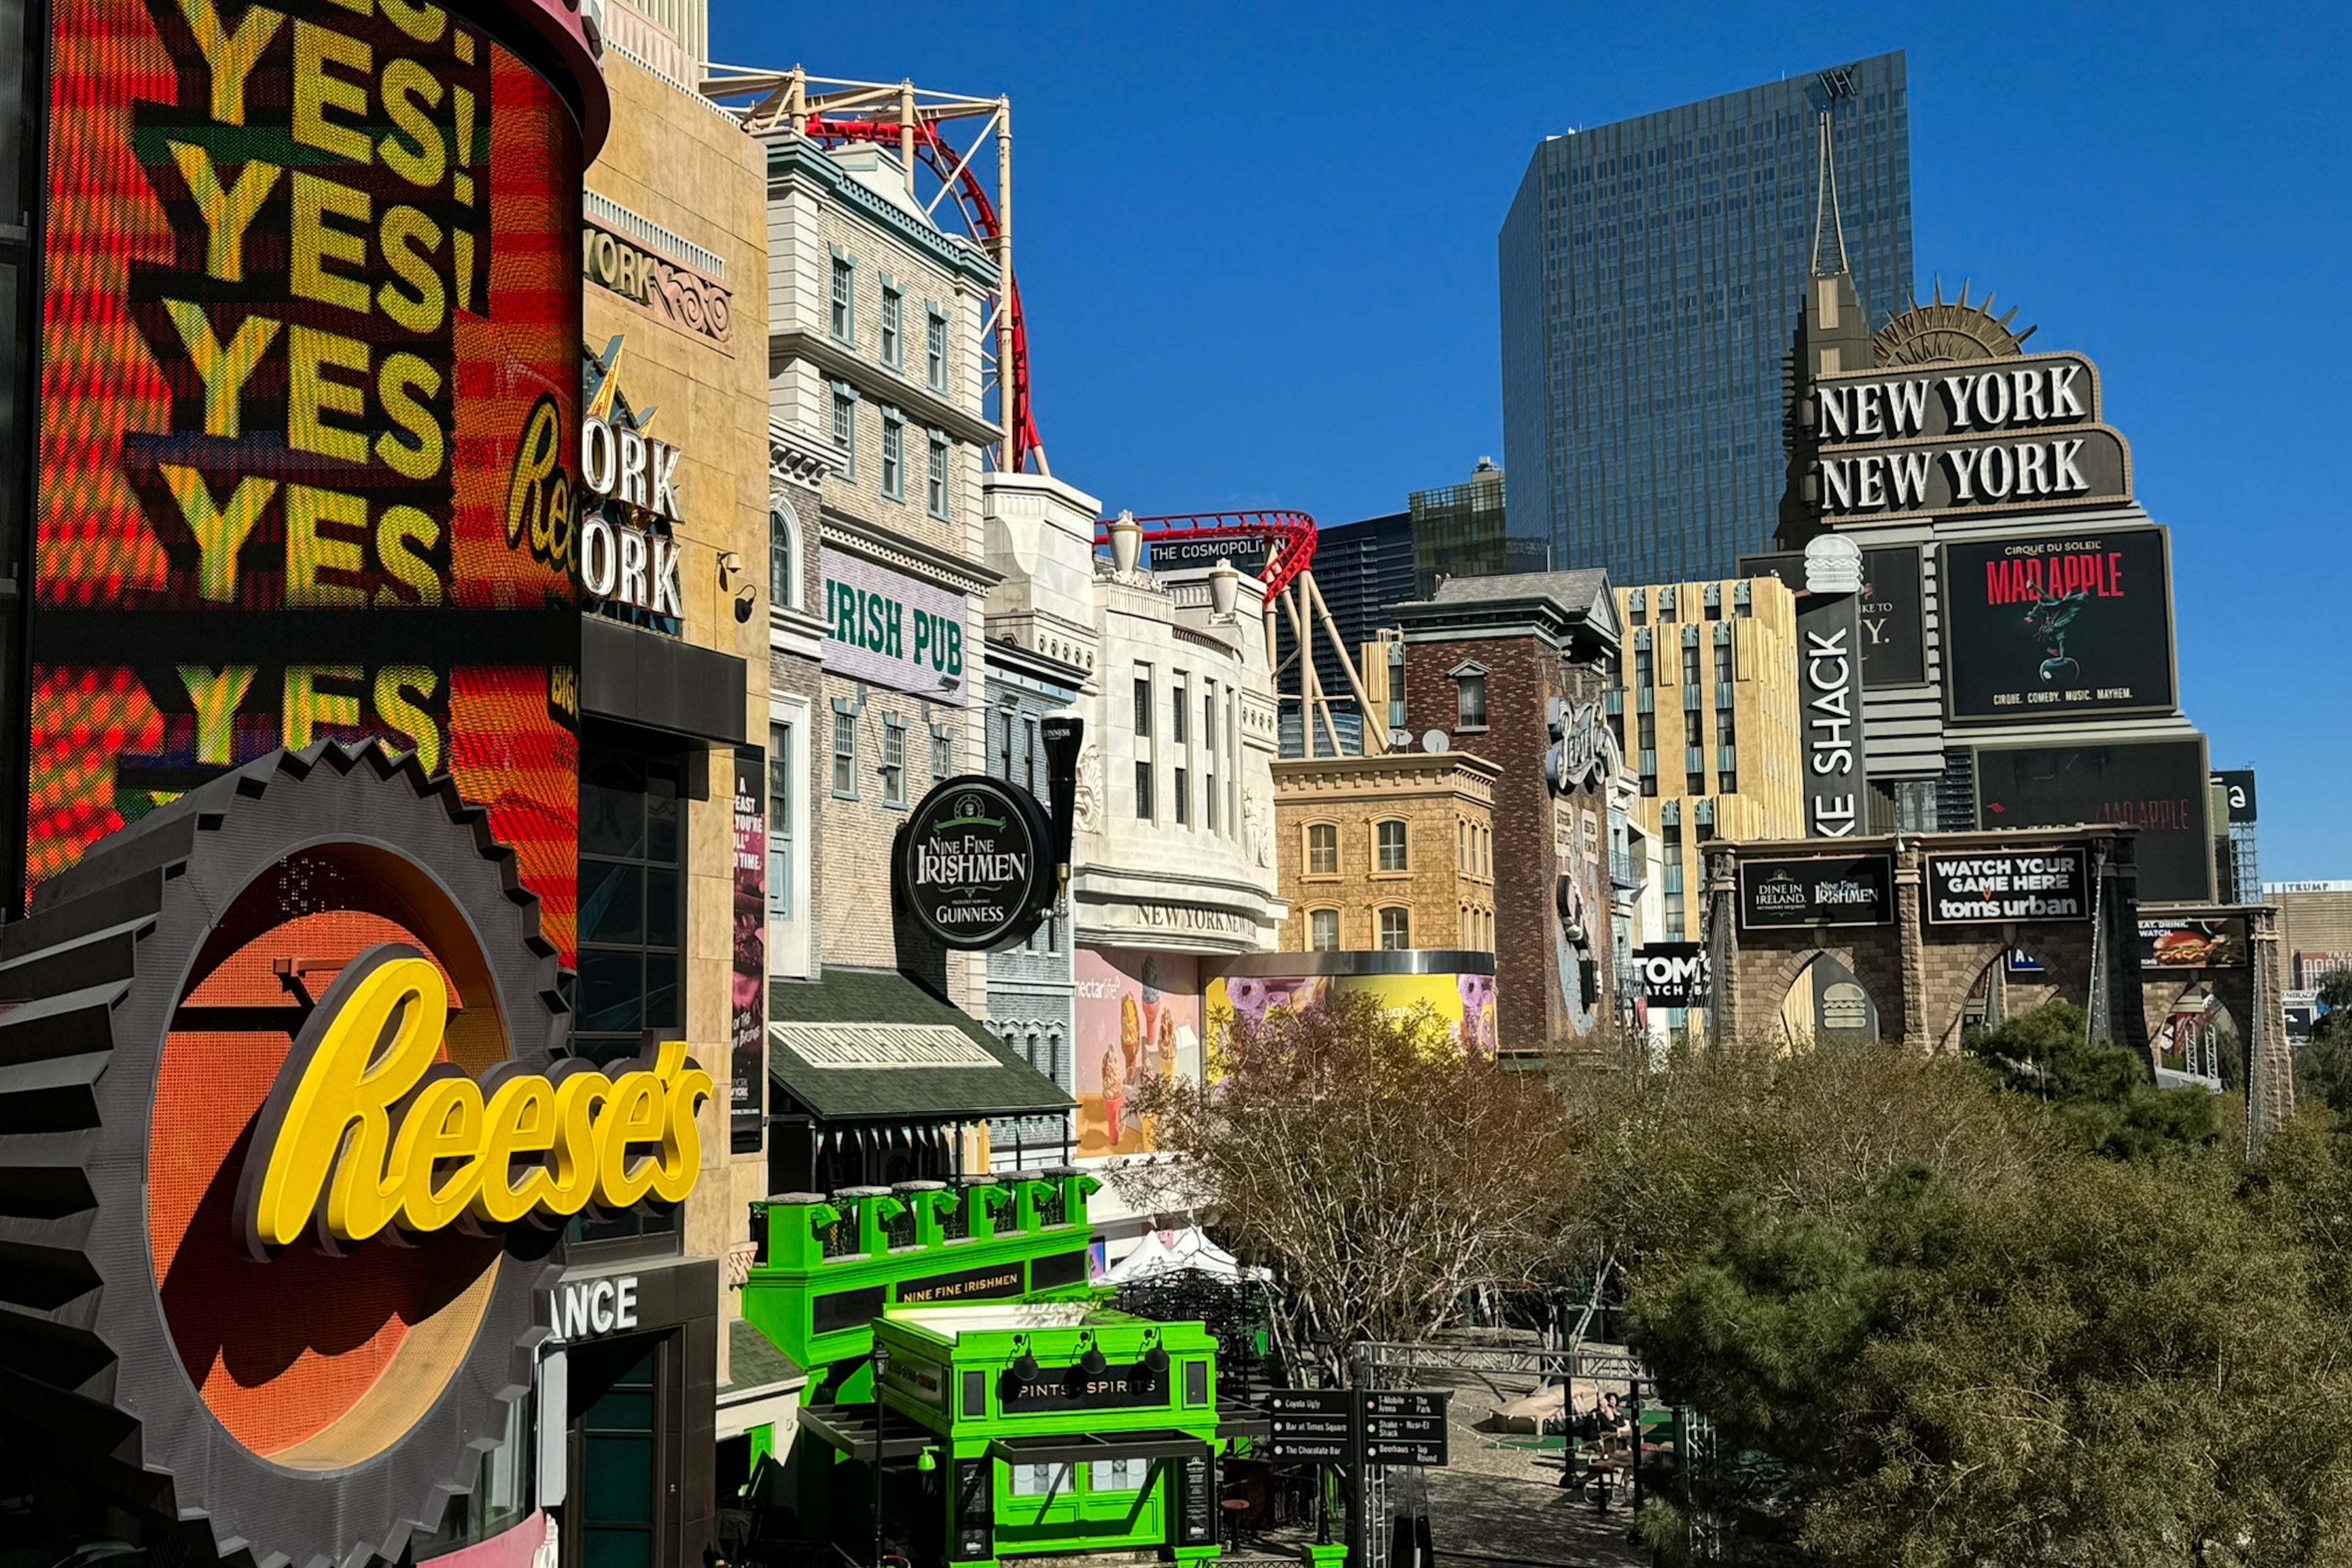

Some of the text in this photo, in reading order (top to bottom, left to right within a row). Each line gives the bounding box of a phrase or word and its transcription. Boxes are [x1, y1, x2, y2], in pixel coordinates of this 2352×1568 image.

[161, 296, 445, 480] YES
[1817, 365, 2087, 438] NEW YORK
[1820, 438, 2090, 510] NEW YORK
[158, 462, 442, 609] YES
[1152, 537, 1286, 561] THE COSMOPOLITN
[2005, 545, 2045, 556] CIRQUE
[2047, 542, 2062, 552] DU
[1986, 552, 2125, 605] MAD APPLE
[1877, 602, 1893, 612] TO
[826, 578, 962, 676] IRISH PUB
[1807, 627, 1853, 775] SHACK
[1994, 687, 2133, 706] CIRQUE. COMEDY. MUSIC. MAYHEM.
[739, 777, 746, 793] A
[735, 813, 763, 834] YOU'RE
[2139, 799, 2189, 831] APPLE
[916, 845, 1027, 884] IRISHMEN
[1936, 858, 2075, 877] WATCH YOUR
[1758, 884, 1803, 895] DINE IN
[1948, 874, 2070, 892] GAME HERE
[2288, 883, 2329, 891] TRUMP
[1756, 894, 1807, 905] IRELAND.
[1814, 885, 1879, 904] IRISHMEN
[936, 905, 1004, 924] GUINNESS
[2003, 895, 2077, 916] urban
[1137, 903, 1180, 928] NEW
[1184, 905, 1224, 930] YORK
[1646, 985, 1683, 996] ATCH
[256, 957, 714, 1245] Reese's
[903, 1273, 1018, 1303] NINE FINE IRISHMEN
[1017, 1379, 1153, 1398] PINTS SPIRITS
[1285, 1399, 1321, 1409] Coyote Ugly
[1378, 1395, 1428, 1404] T-Mobile The
[1286, 1422, 1297, 1431] Bar
[1306, 1422, 1324, 1431] Times
[1325, 1422, 1348, 1432] Square
[1379, 1420, 1398, 1429] Shake
[1379, 1428, 1399, 1437] Shack
[1286, 1446, 1341, 1455] The Chocolate Bar
[1417, 1444, 1428, 1455] Top
[1417, 1453, 1438, 1463] Round
